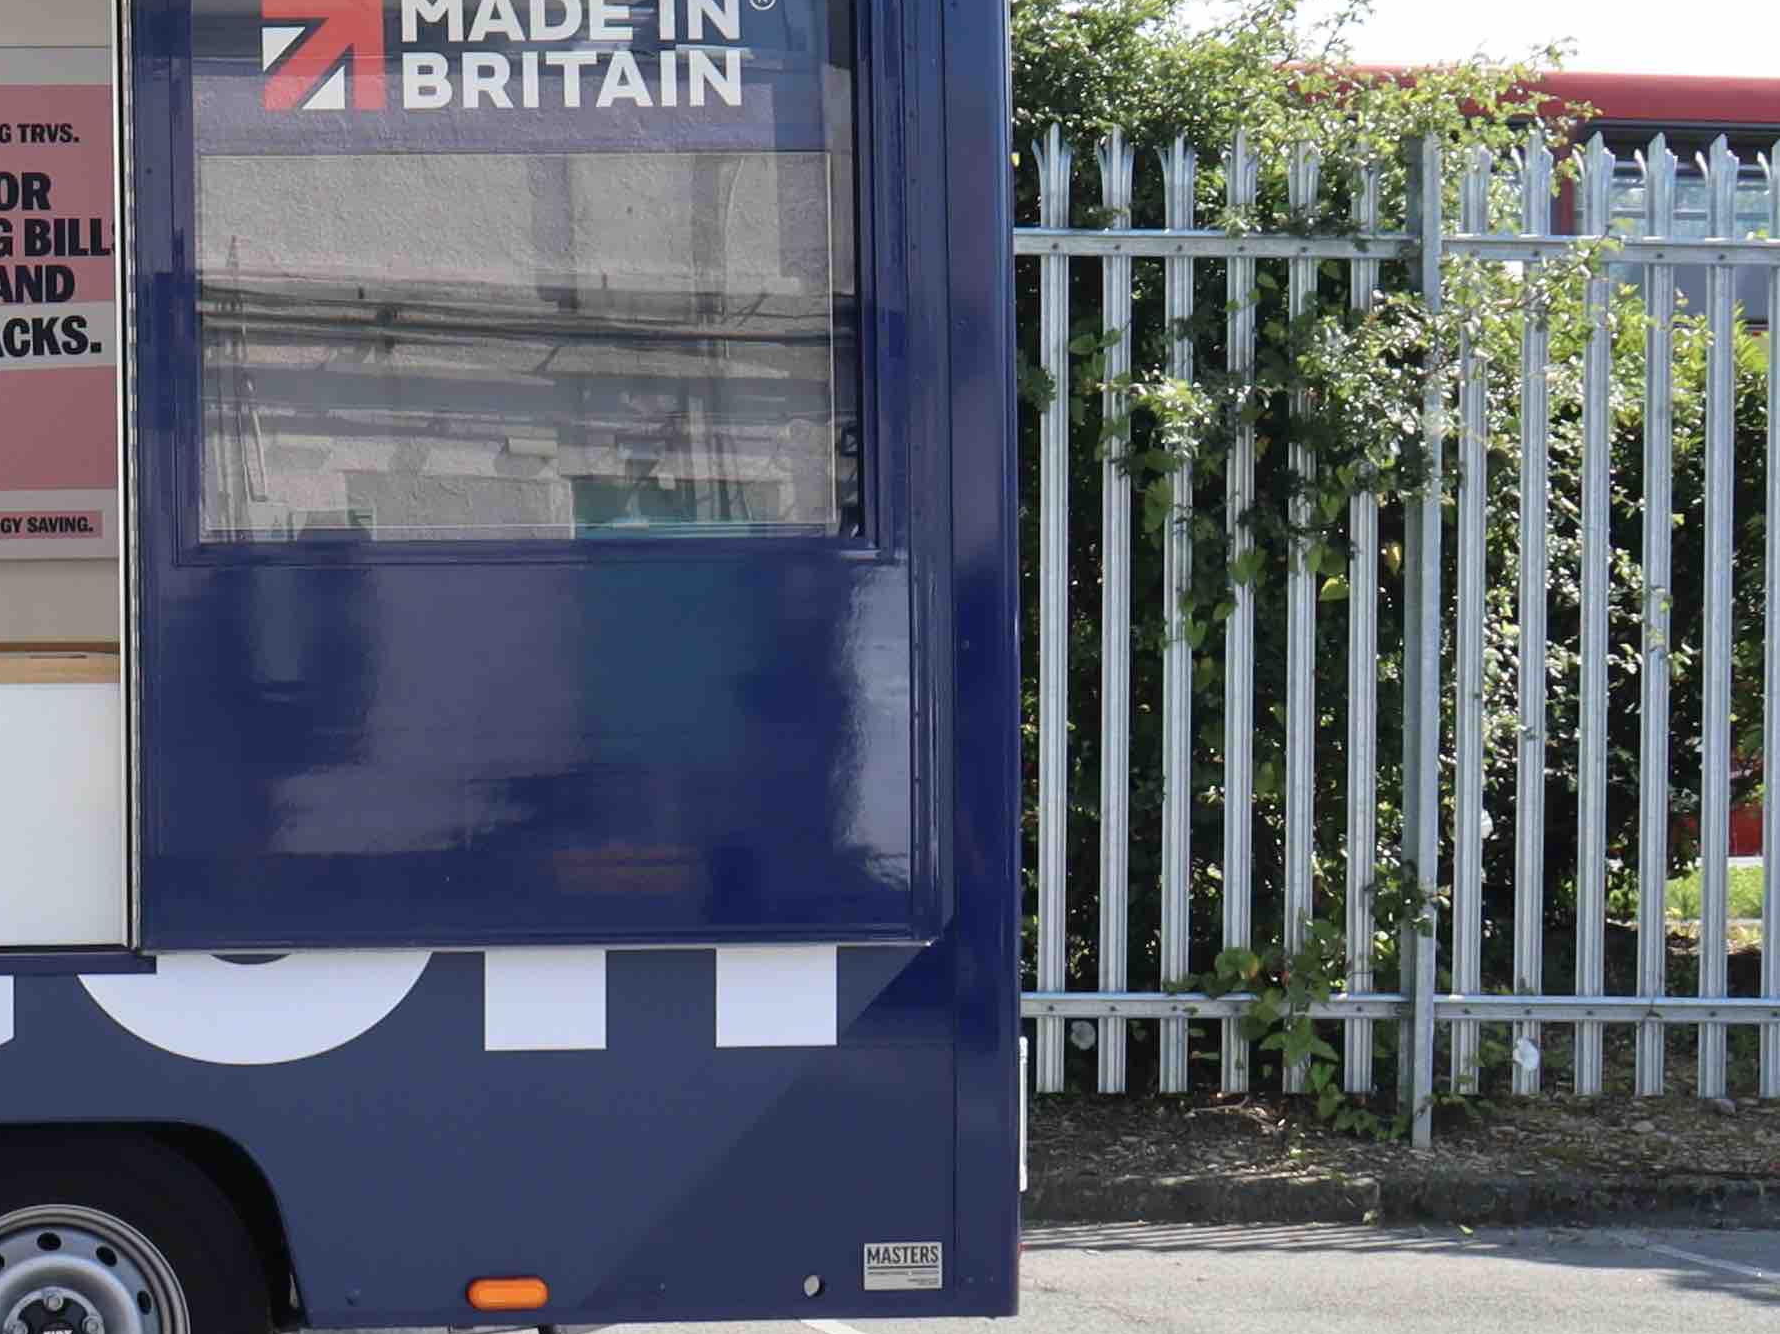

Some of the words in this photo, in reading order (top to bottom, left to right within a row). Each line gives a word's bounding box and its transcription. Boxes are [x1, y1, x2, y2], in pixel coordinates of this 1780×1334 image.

[403, 51, 743, 109] BRITAIN
[17, 123, 79, 143] TRVS.
[25, 218, 116, 257] BILL
[27, 516, 93, 534] SAVING.
[867, 1245, 938, 1265] MASTERS
